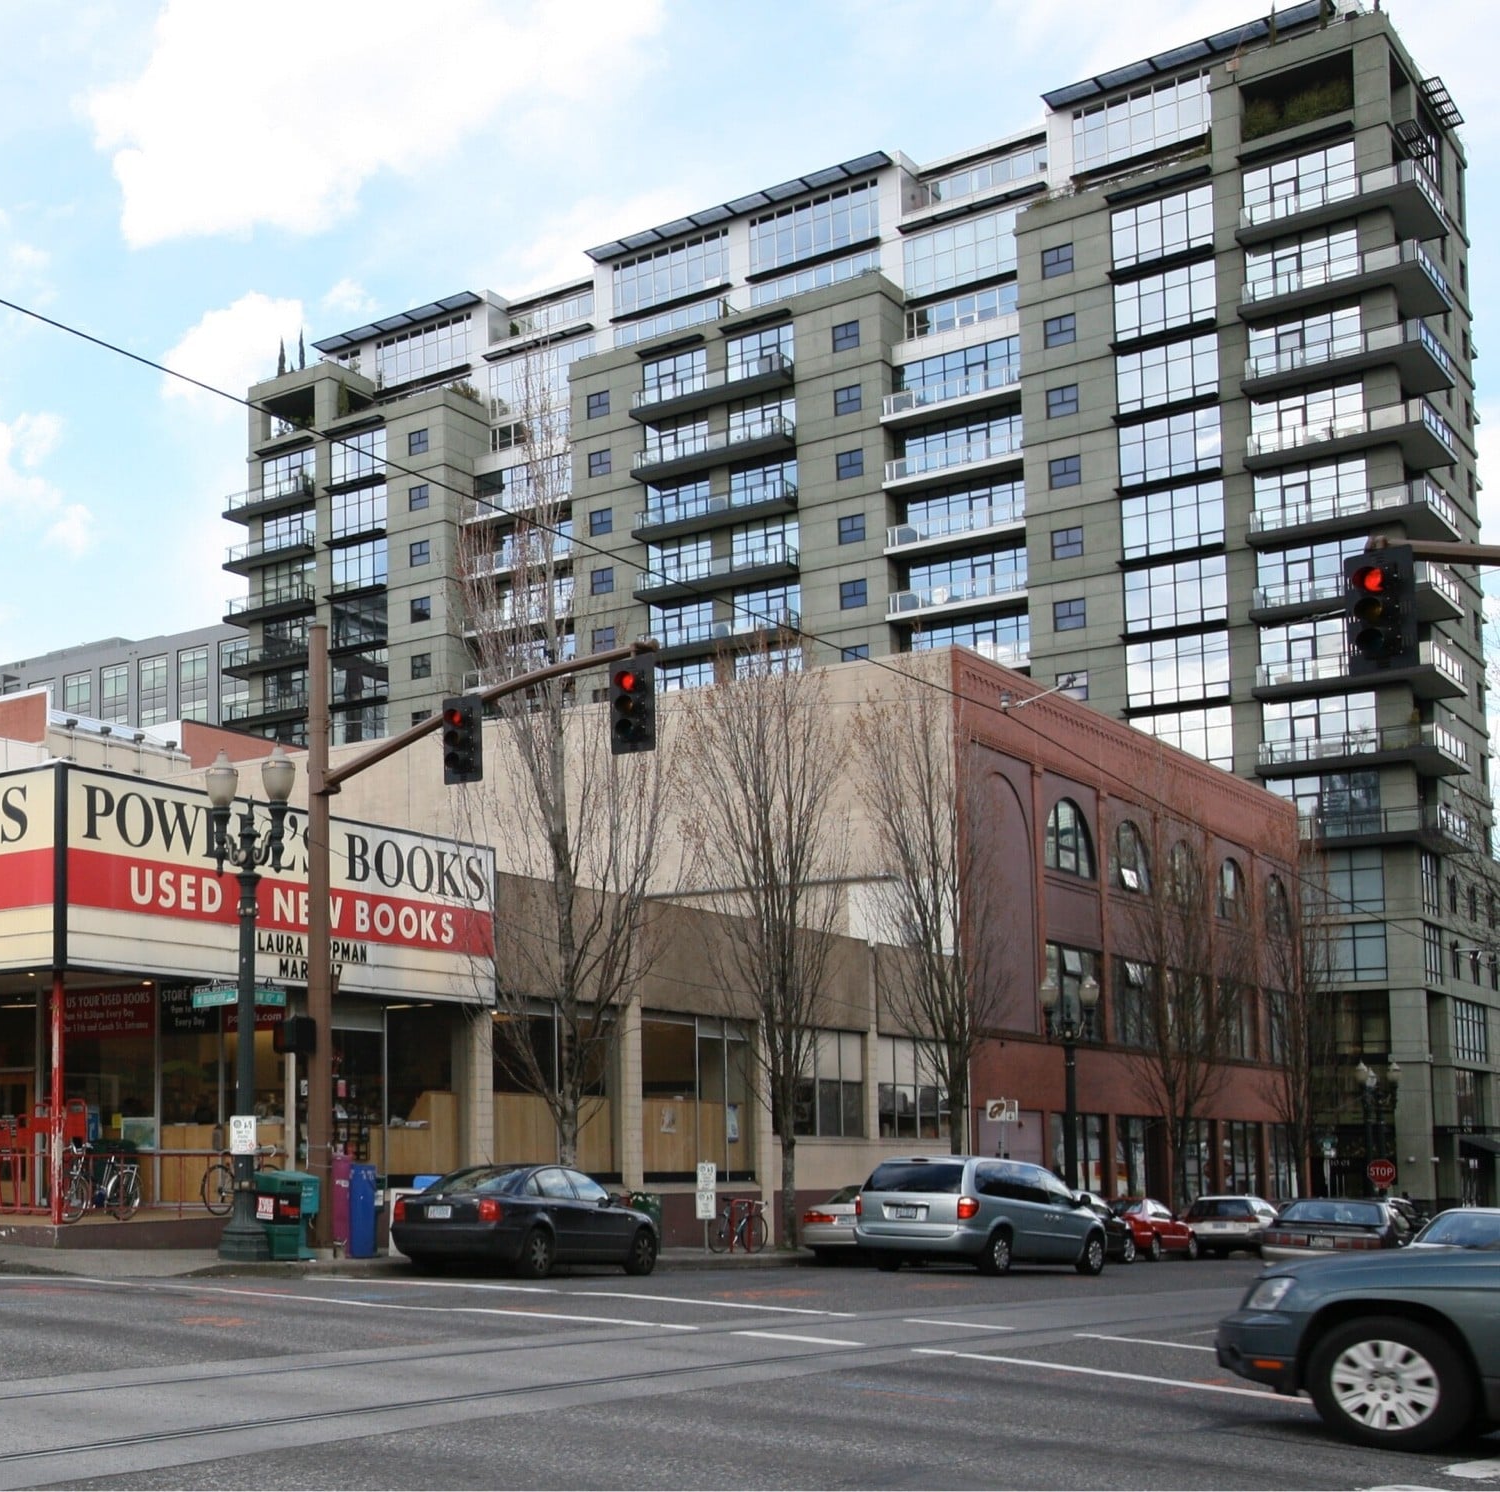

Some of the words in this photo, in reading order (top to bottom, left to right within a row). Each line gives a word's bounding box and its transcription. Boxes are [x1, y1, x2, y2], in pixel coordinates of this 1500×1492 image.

[344, 832, 486, 902] BOOKS
[130, 866, 222, 914] USED
[355, 899, 455, 945] BOOKS
[257, 931, 304, 956] LAURA
[66, 996, 77, 1009] US
[79, 994, 101, 1008] YOUR
[101, 993, 122, 1007] USED
[123, 991, 151, 1005] BOOKS
[162, 988, 188, 1002] STORE
[106, 1010, 122, 1020] Every
[123, 1008, 135, 1018] Day
[184, 1005, 192, 1013] to
[87, 1023, 97, 1031] and
[175, 1017, 192, 1028] Every
[193, 1016, 206, 1028] Day
[1369, 1166, 1393, 1177] STOP
